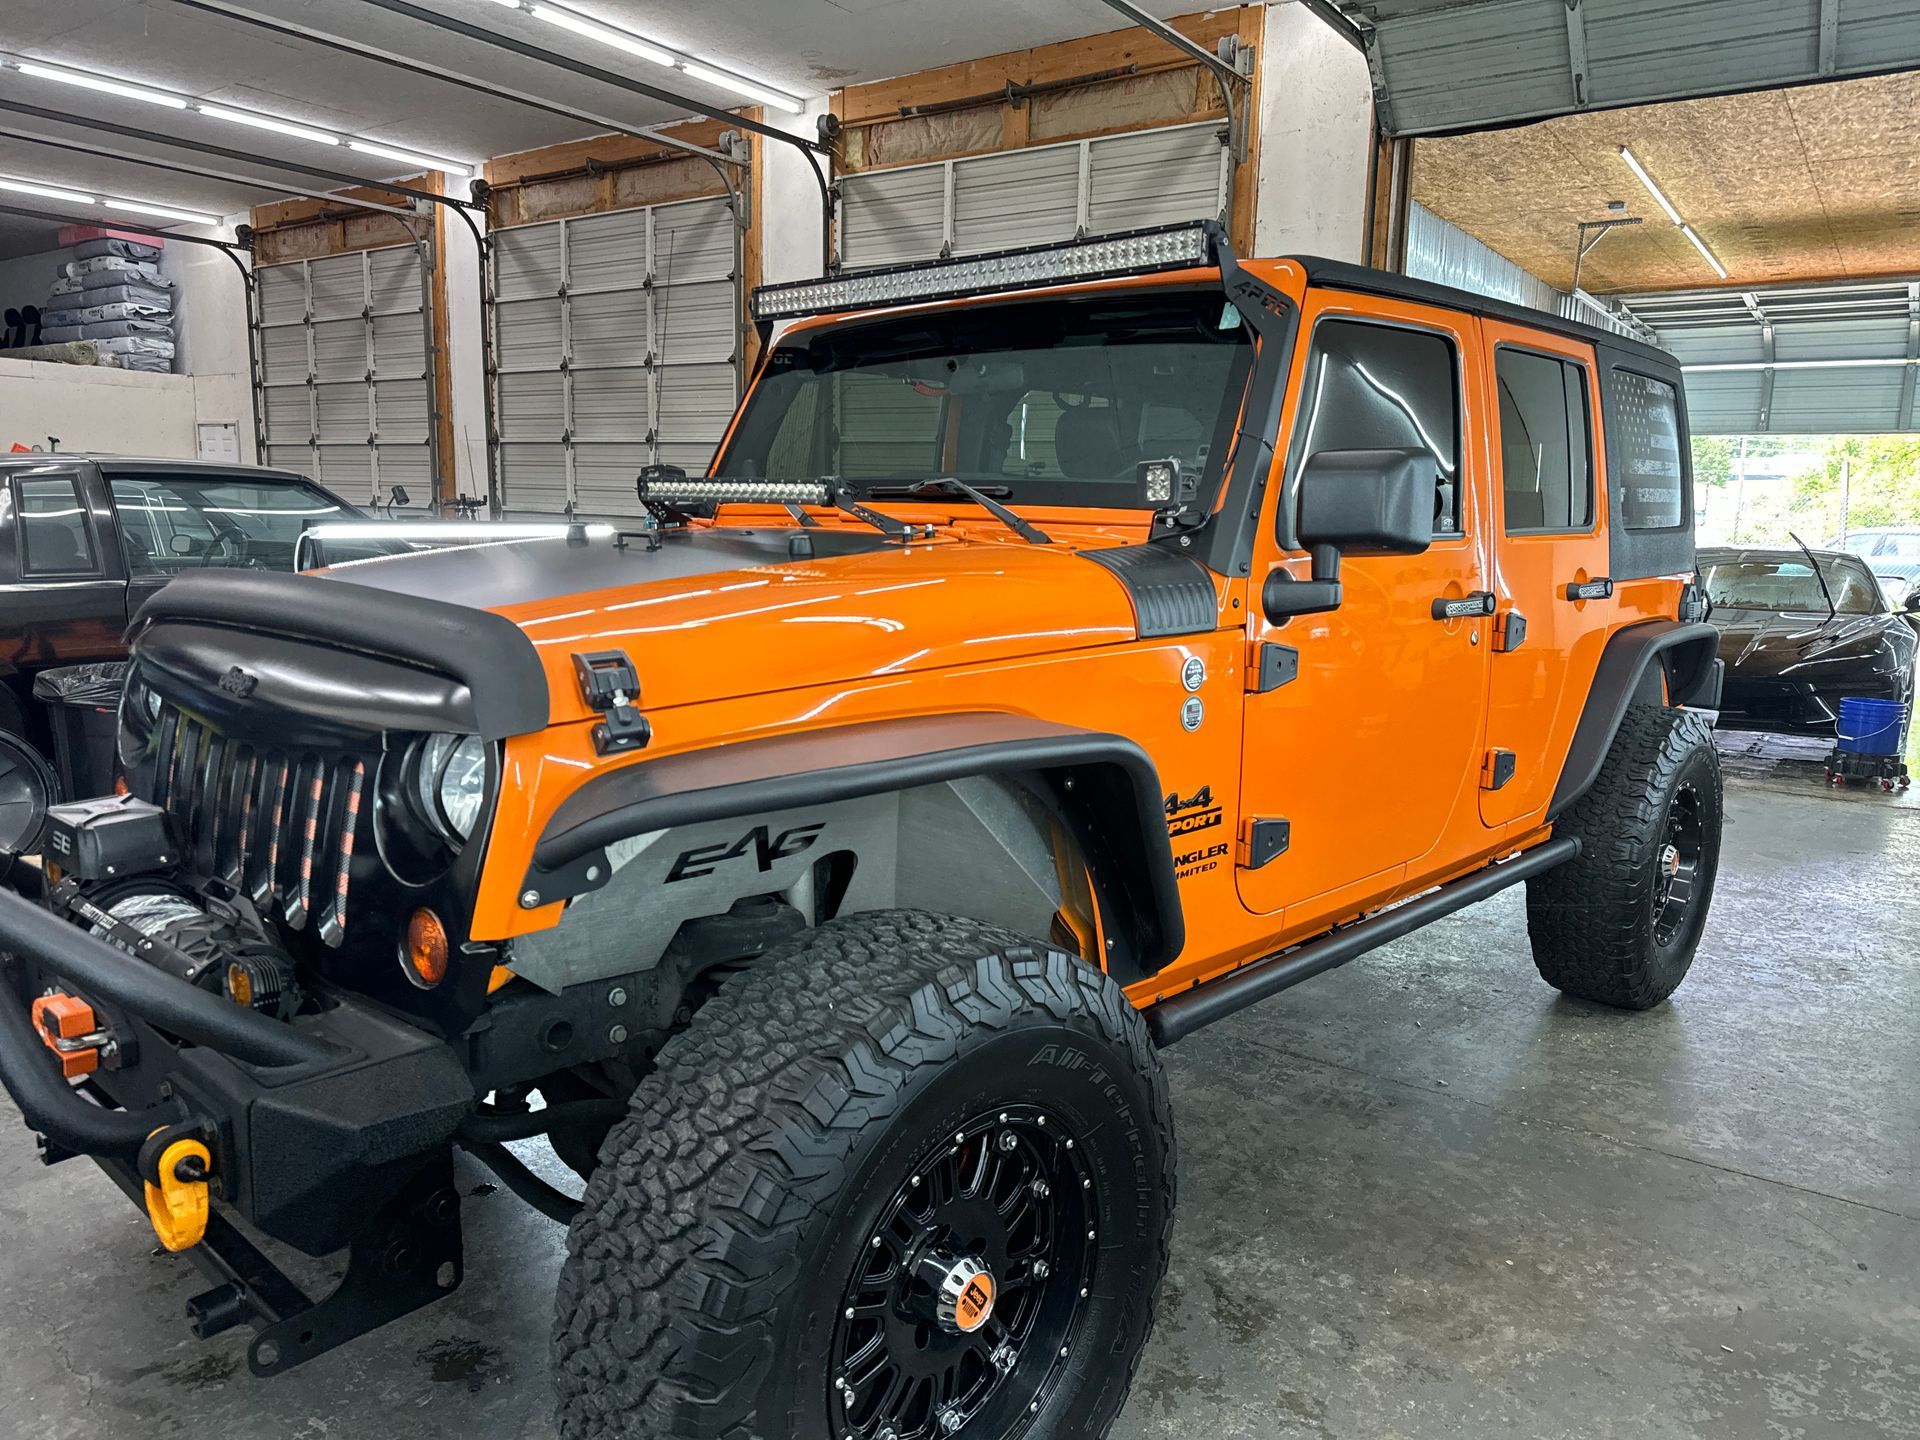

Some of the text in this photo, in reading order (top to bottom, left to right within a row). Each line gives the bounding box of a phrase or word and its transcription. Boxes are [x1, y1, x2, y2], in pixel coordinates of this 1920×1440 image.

[1166, 812, 1217, 835] PORT
[1173, 842, 1229, 868] NGLER
[1176, 861, 1218, 880] IMITED
